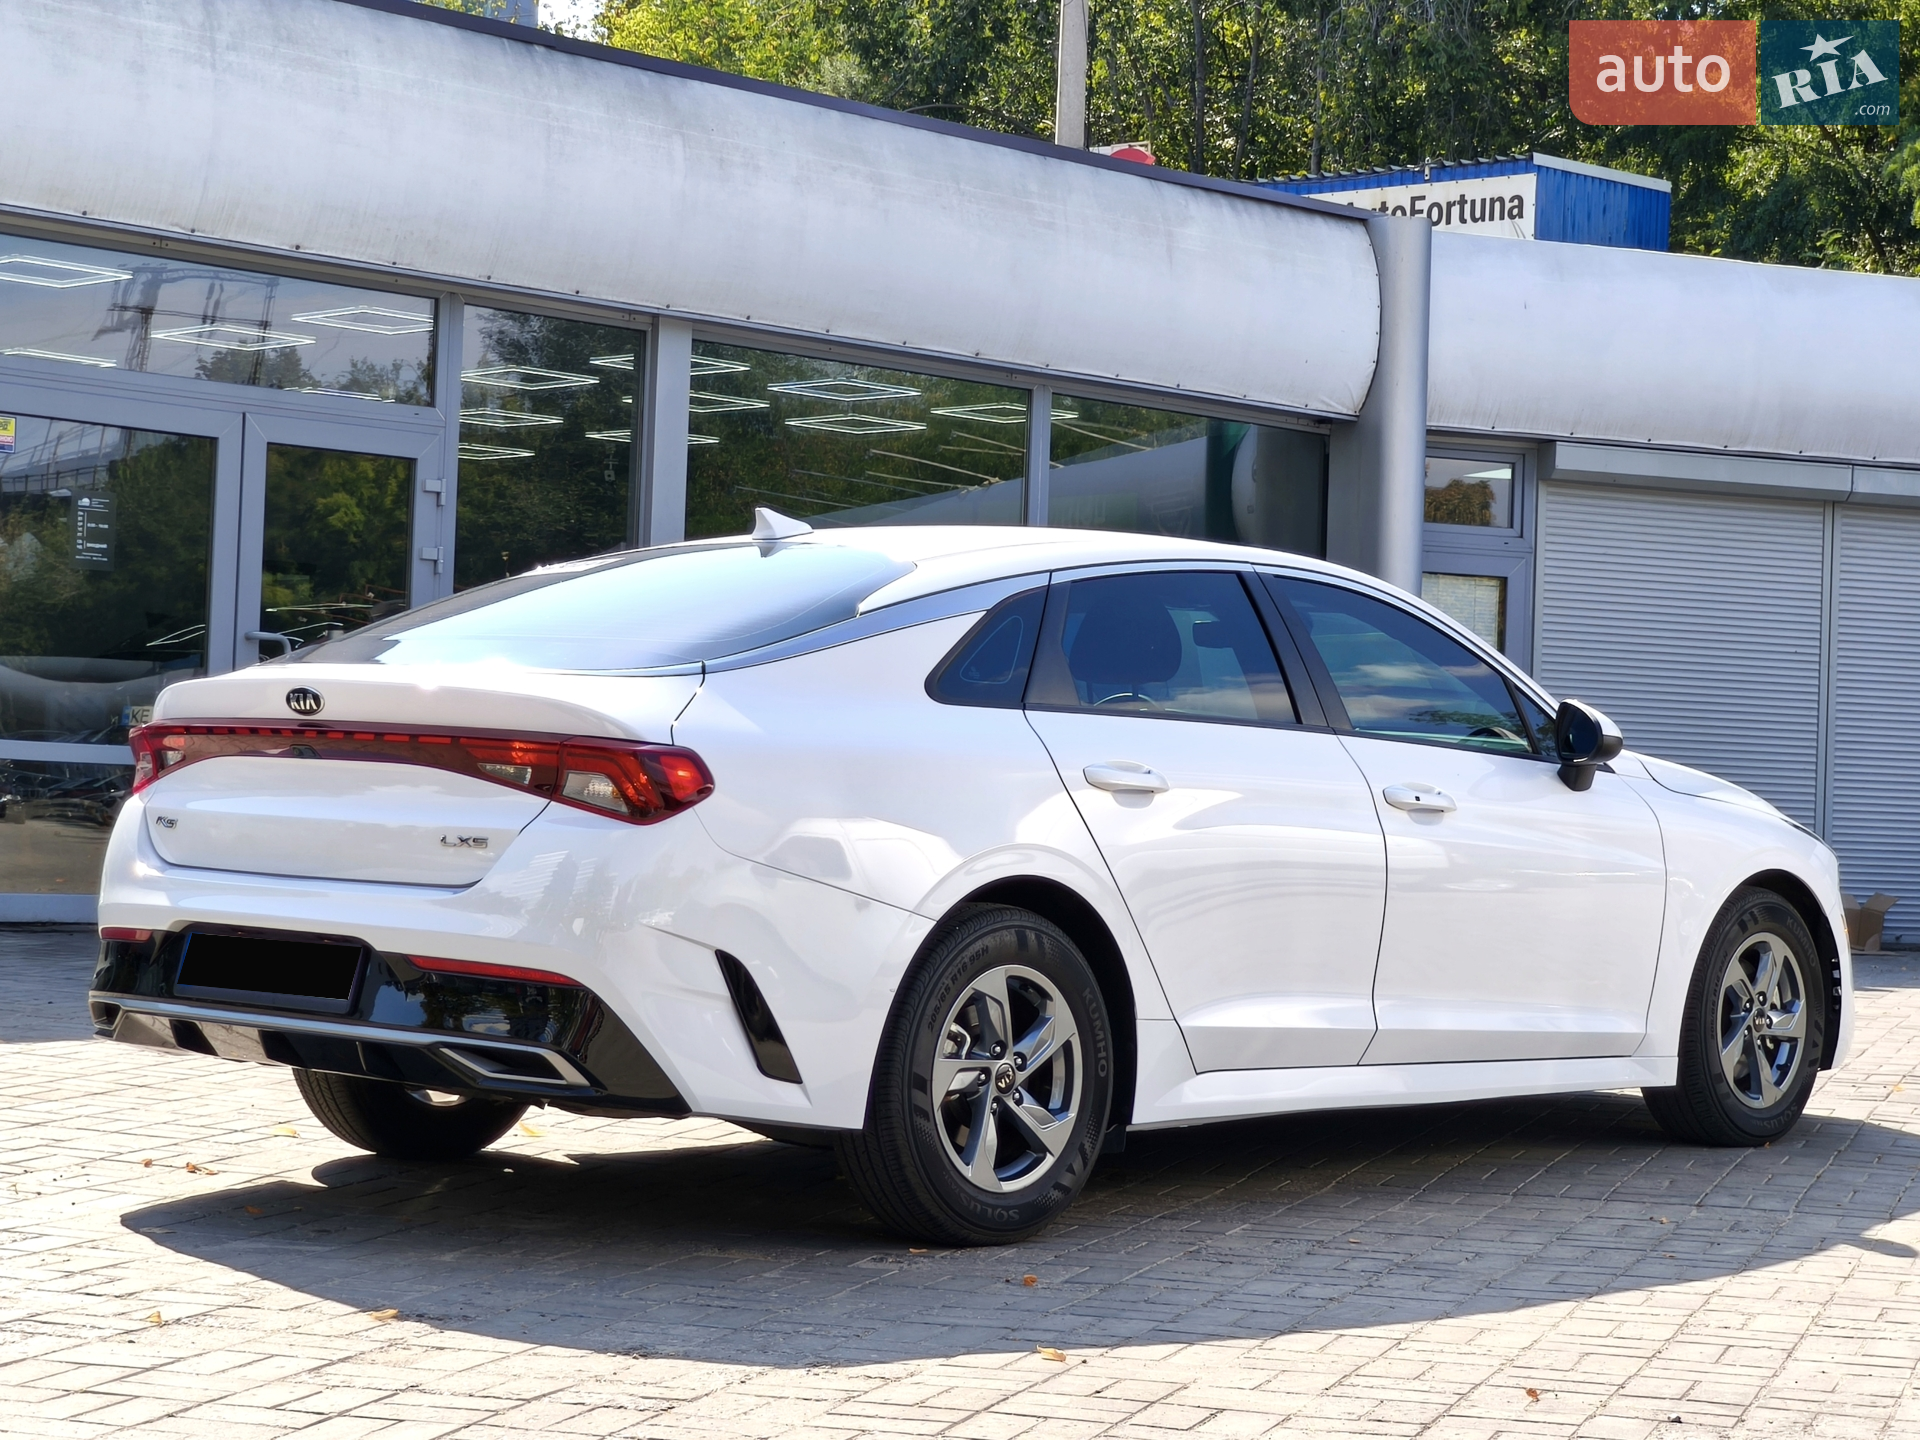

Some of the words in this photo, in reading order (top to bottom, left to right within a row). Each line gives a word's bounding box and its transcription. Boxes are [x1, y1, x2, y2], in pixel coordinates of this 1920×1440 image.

[290, 693, 318, 710] KIA
[156, 815, 178, 829] K5
[1082, 987, 1108, 1077] KUMHO
[959, 1192, 1020, 1222] SOLUS
